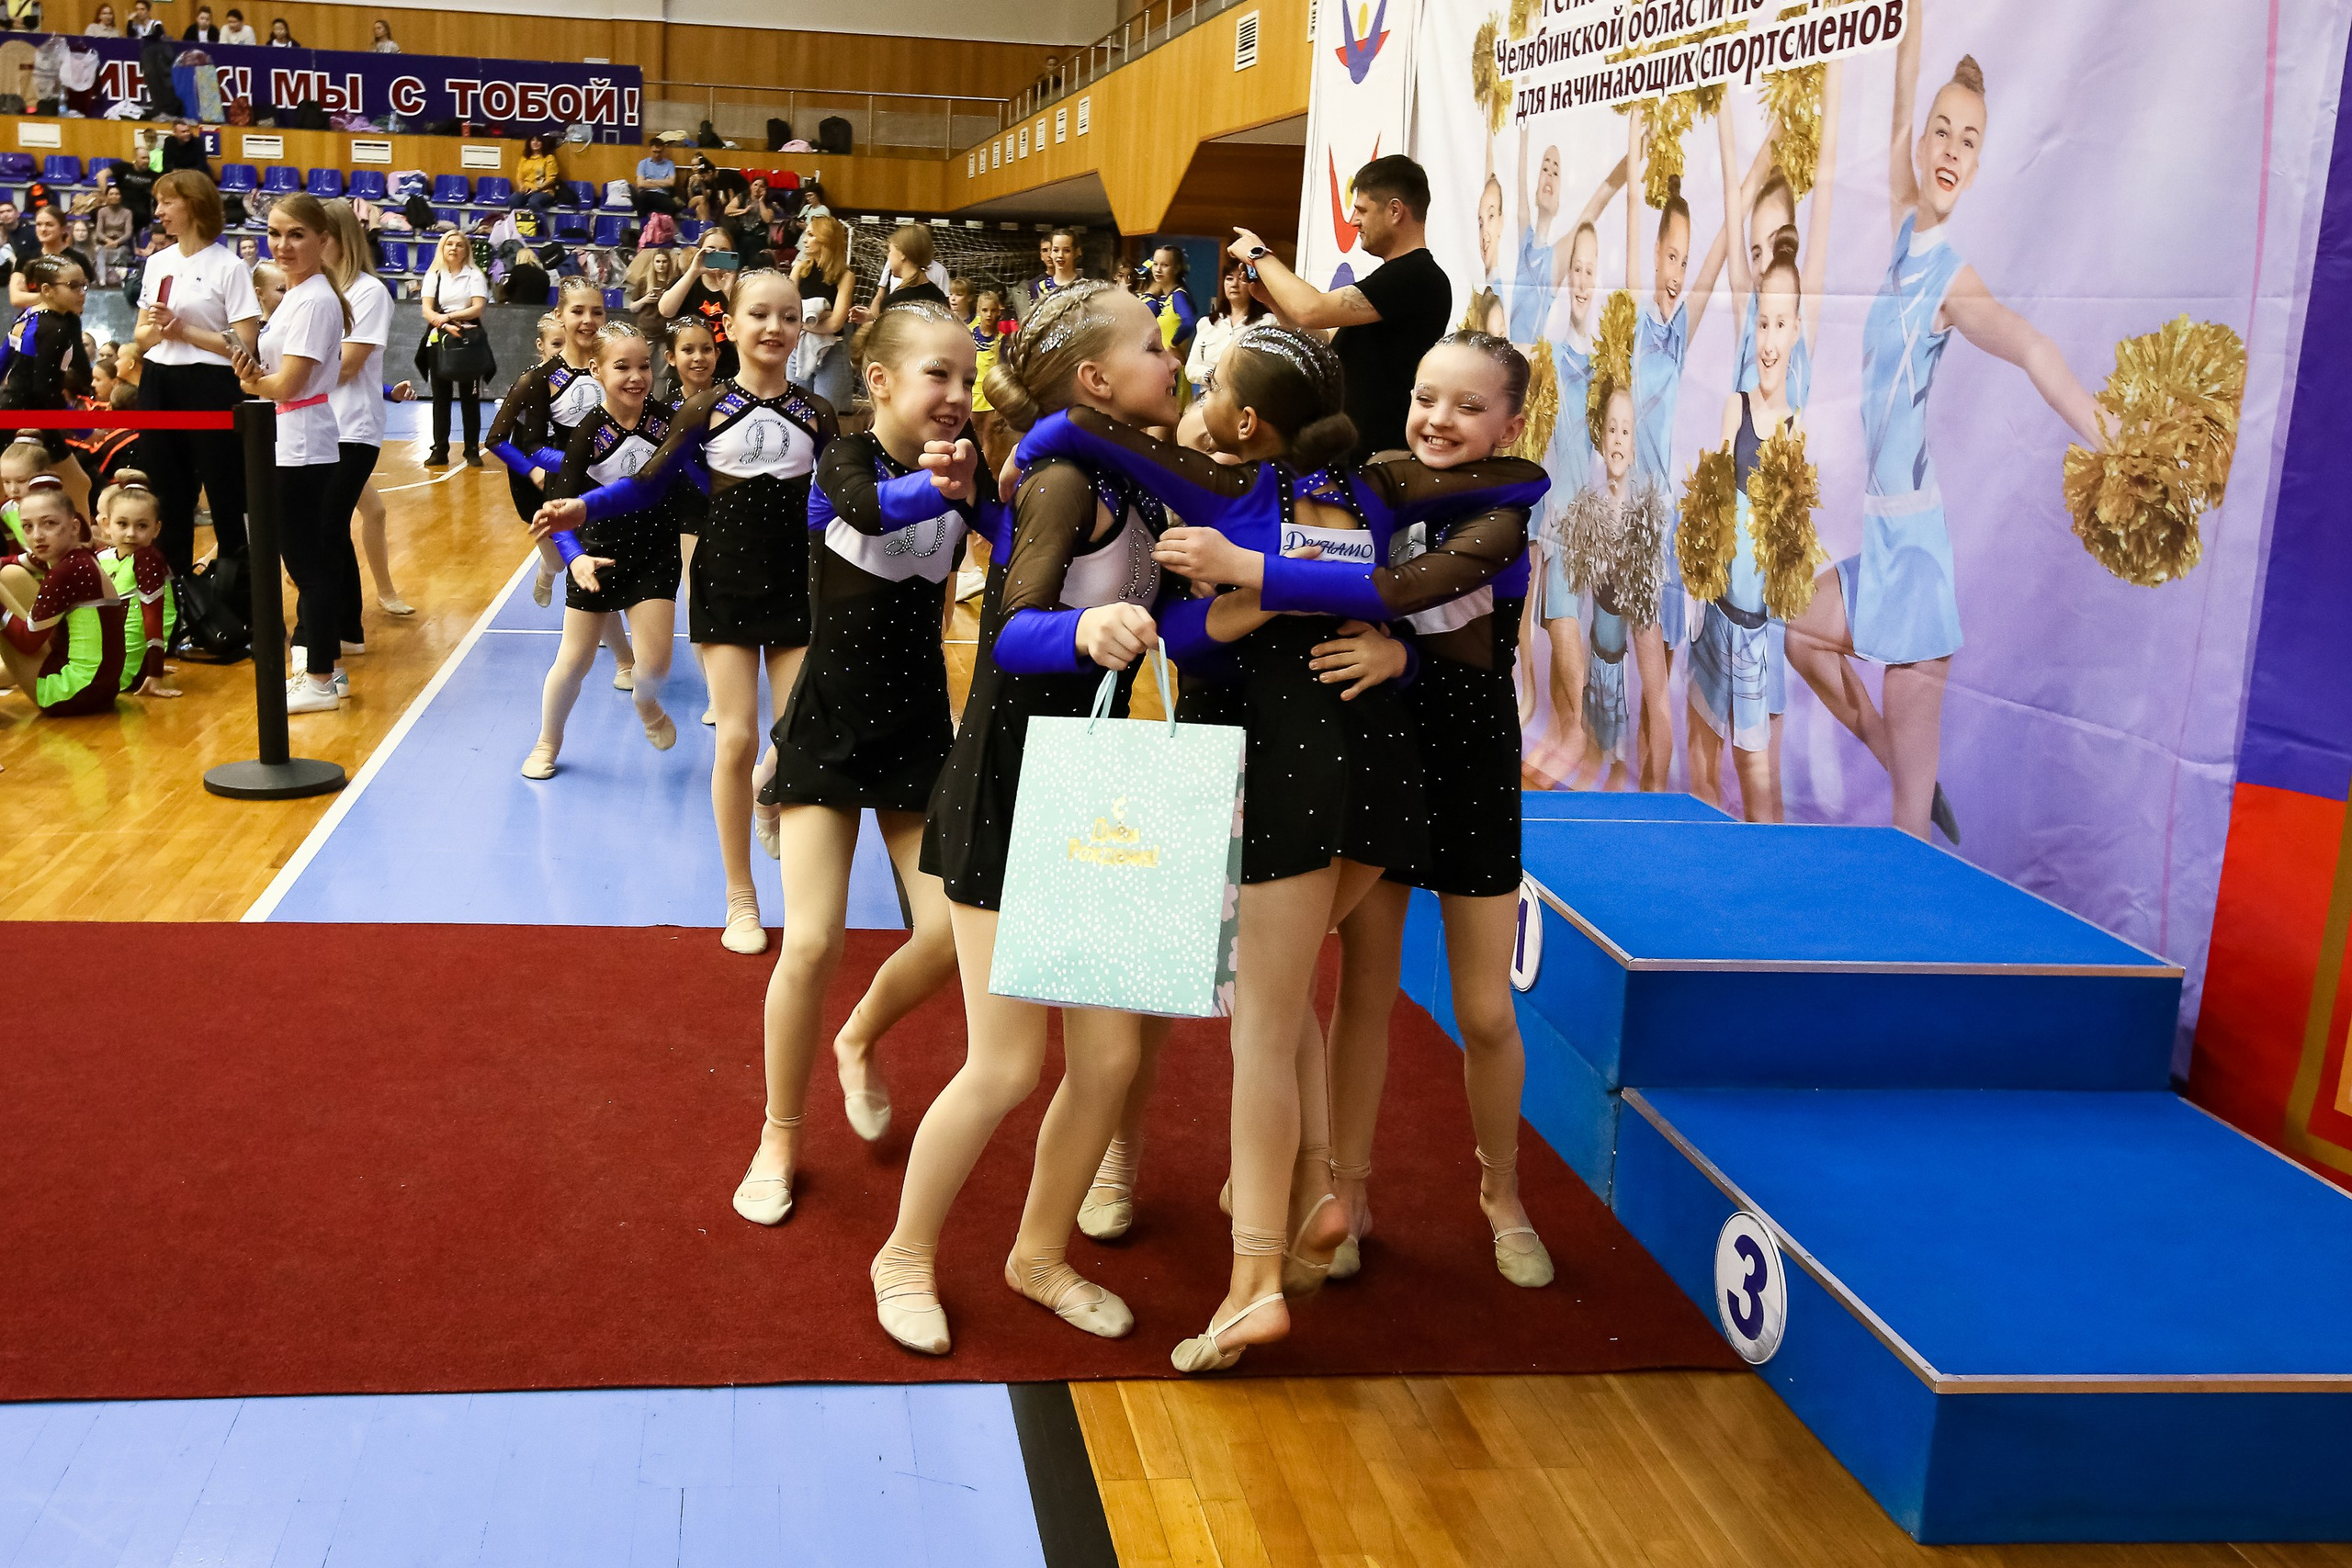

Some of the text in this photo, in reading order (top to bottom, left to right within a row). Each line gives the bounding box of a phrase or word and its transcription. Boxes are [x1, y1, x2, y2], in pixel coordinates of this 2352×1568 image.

[1497, 0, 1724, 76] Челябинской области
[1515, 0, 1904, 126] для начинающих спортсменов
[270, 68, 363, 114] МЫ
[389, 75, 427, 117] С
[445, 77, 640, 127] ТОБОЙ!
[1726, 1234, 1768, 1341] 3
